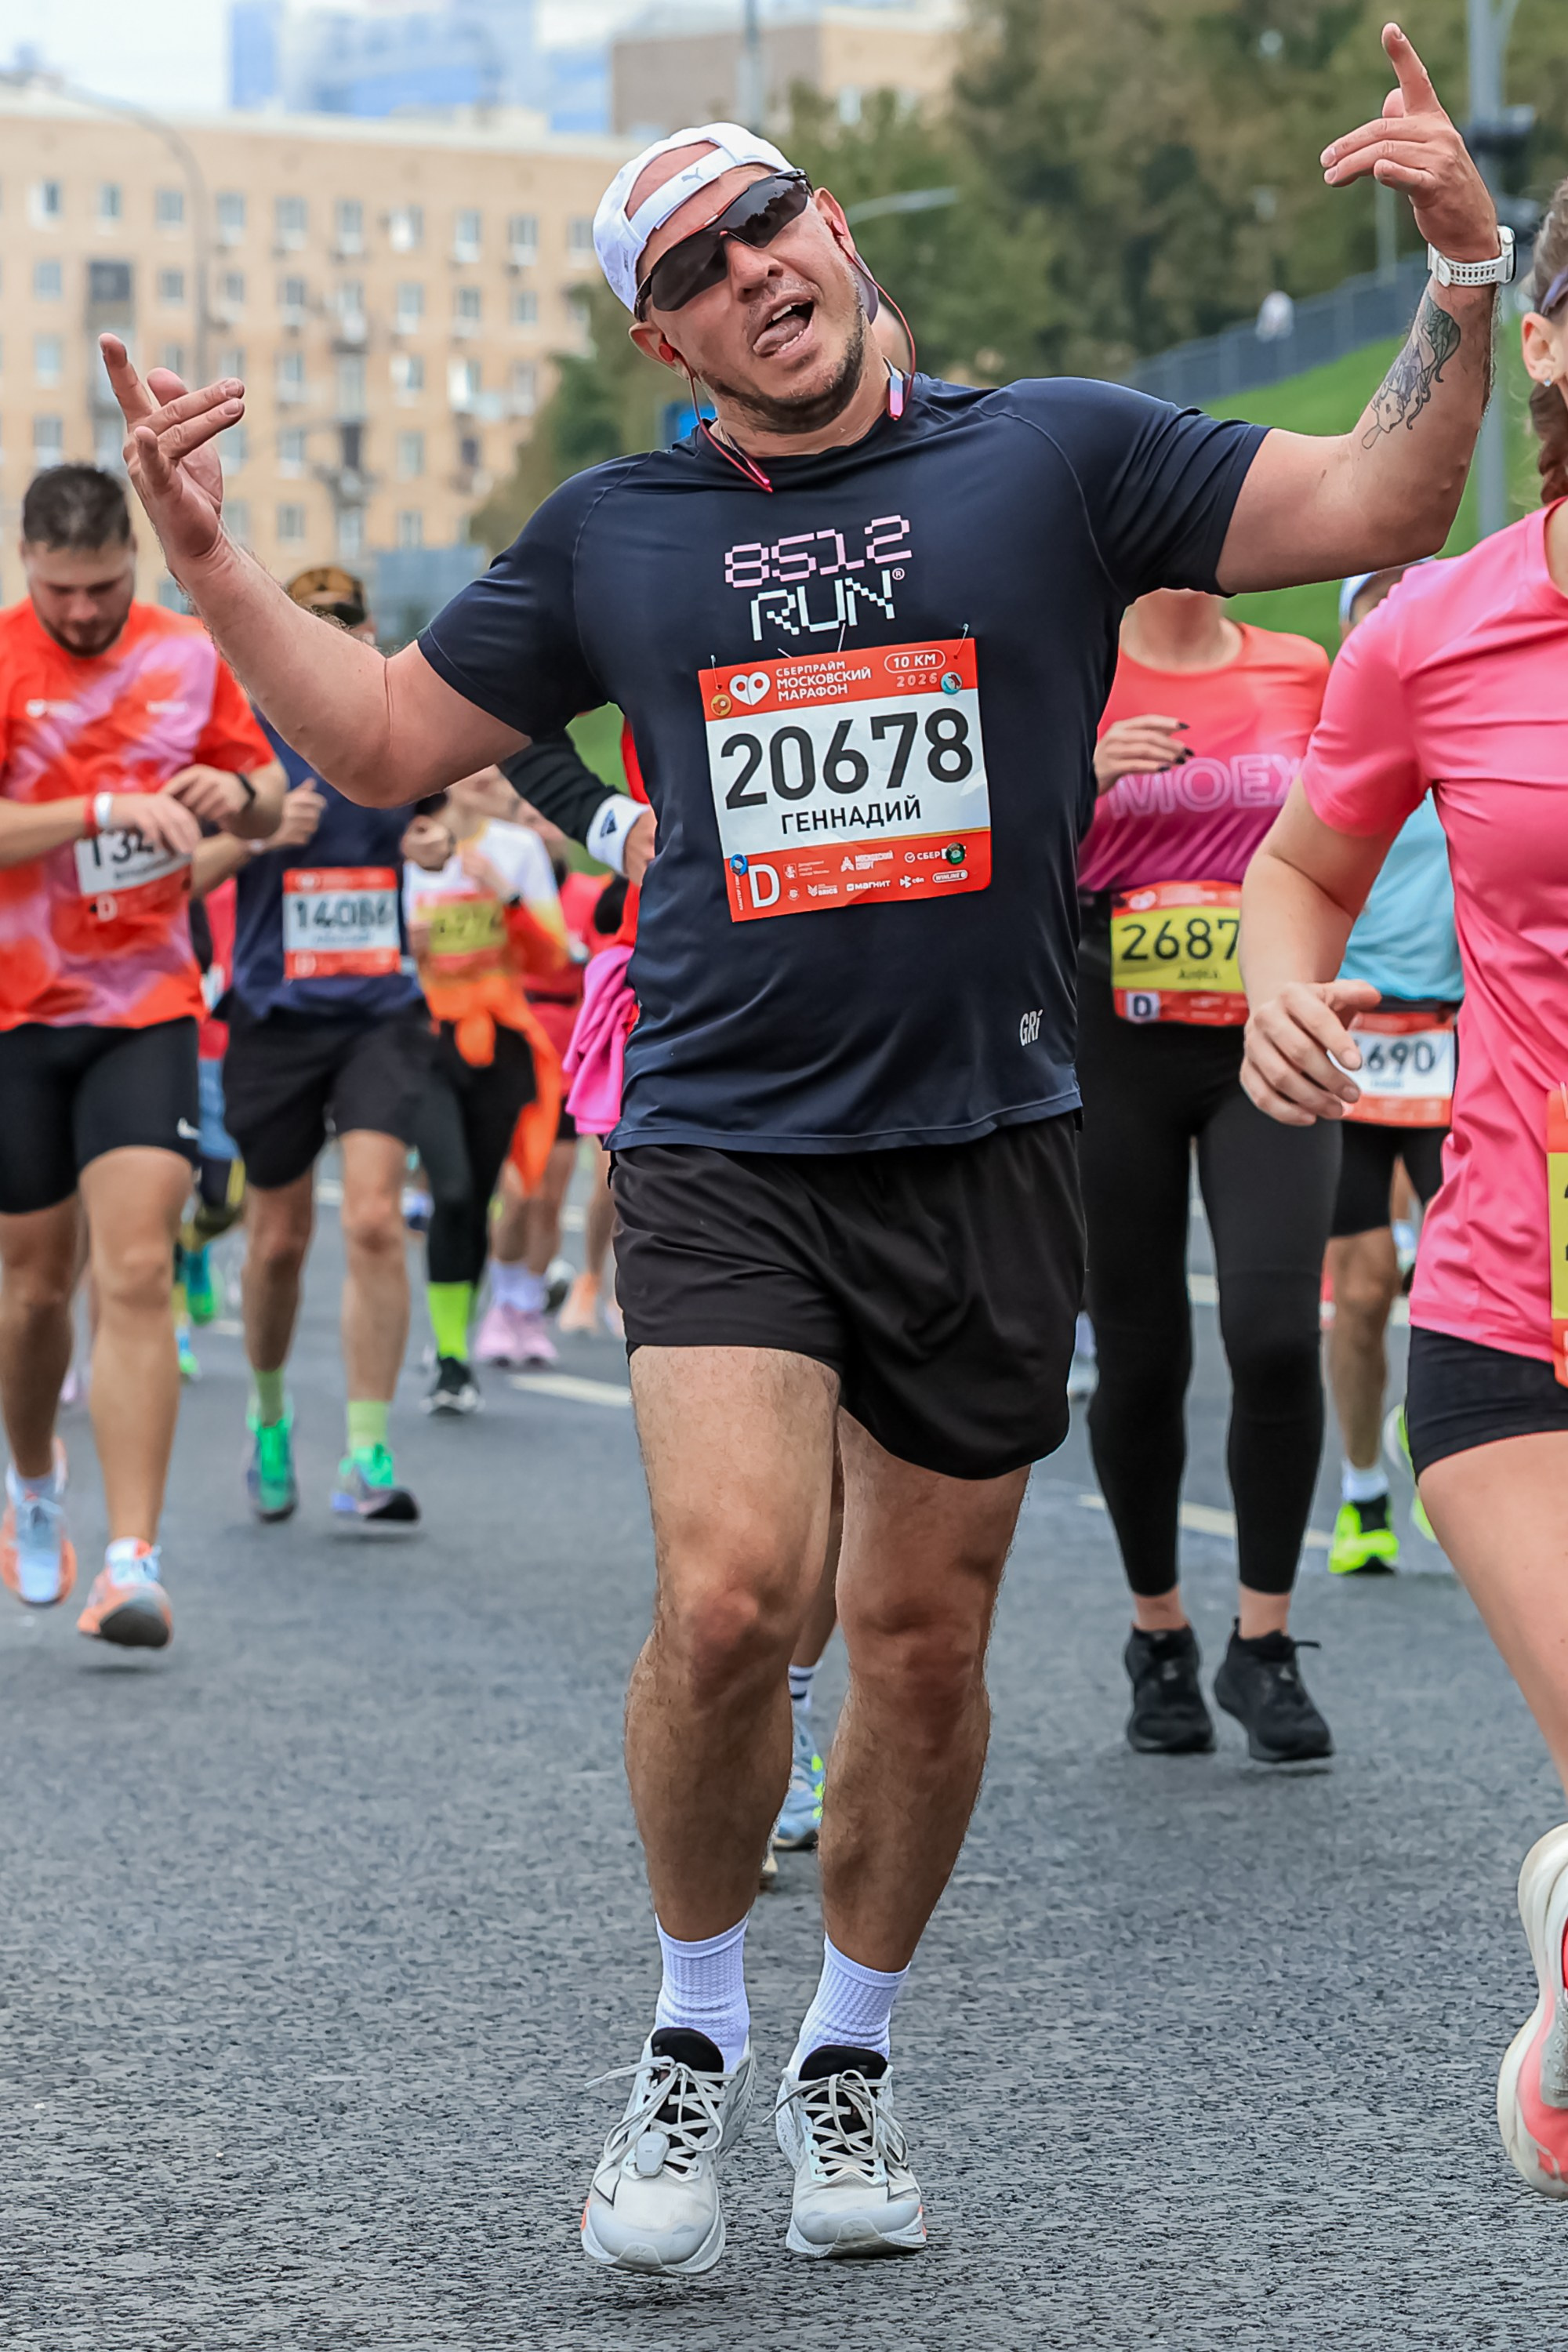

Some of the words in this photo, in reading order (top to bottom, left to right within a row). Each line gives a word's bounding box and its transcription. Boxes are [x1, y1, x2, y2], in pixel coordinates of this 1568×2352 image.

[724, 514, 913, 588] 8512
[775, 661, 845, 677] СБЕРПРАЙМ
[893, 656, 910, 669] 10
[776, 666, 872, 690] МОСКОВСКИЙ
[896, 672, 938, 688] 2026
[777, 683, 848, 702] МАРАФОН
[720, 708, 973, 810] 20678
[781, 794, 921, 835] ГЕННАДИЙ
[916, 851, 940, 861] СБЕР
[748, 863, 781, 909] D
[1121, 918, 1240, 960] 2687
[1134, 995, 1152, 1017] D
[1354, 1040, 1436, 1074] 690
